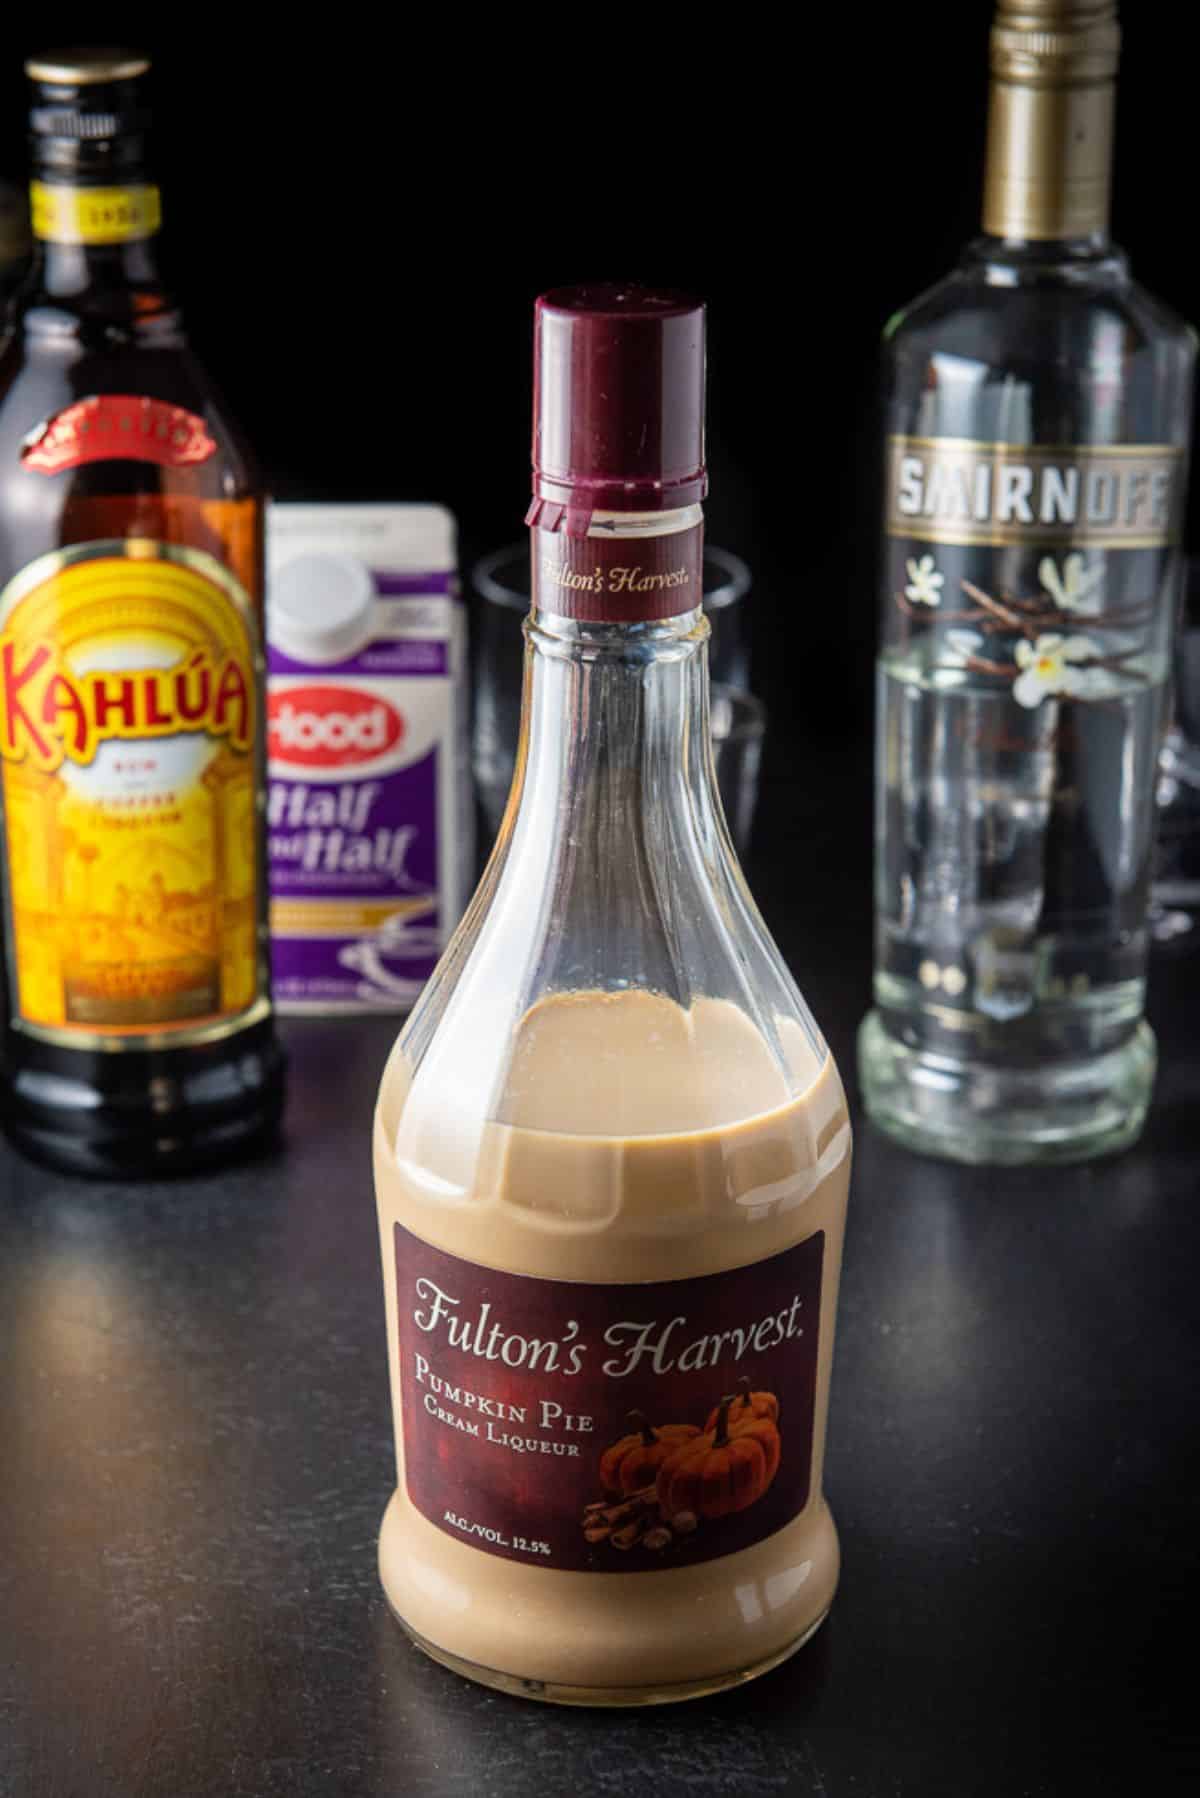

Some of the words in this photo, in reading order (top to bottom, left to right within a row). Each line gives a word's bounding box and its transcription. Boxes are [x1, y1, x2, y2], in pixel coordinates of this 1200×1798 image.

[899, 455, 1171, 526] SMIRNOFF
[2, 640, 249, 758] KAHLÚA
[267, 781, 381, 833] Half
[302, 826, 418, 878] Half
[414, 1277, 588, 1376] Fulton's
[513, 1536, 552, 1555] 12.5%
